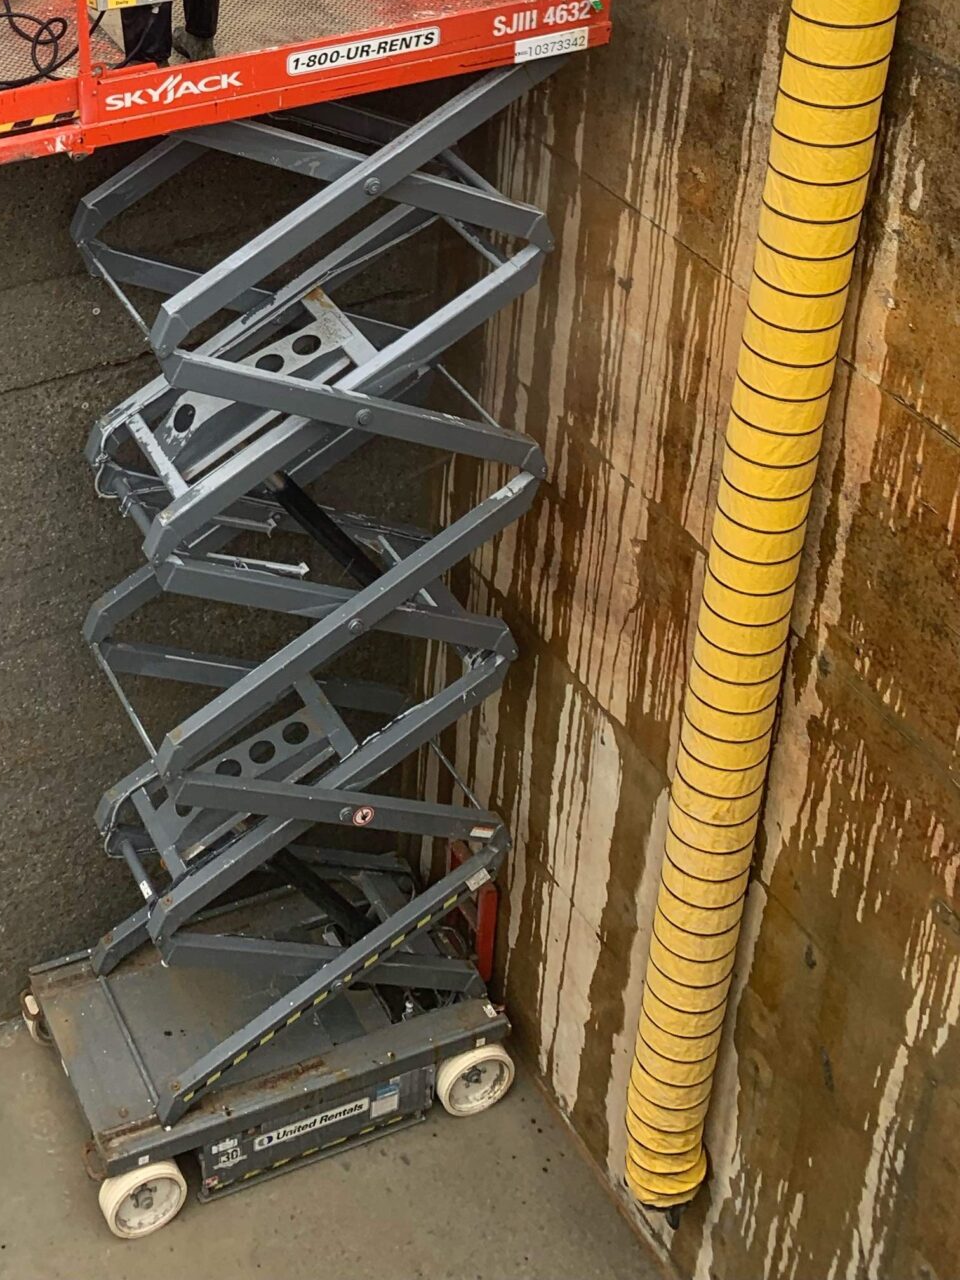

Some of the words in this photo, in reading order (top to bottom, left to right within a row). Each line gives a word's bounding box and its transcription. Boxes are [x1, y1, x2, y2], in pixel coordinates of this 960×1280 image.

[543, 0, 592, 26] 4632
[292, 31, 436, 71] 1-800-UR-RENTS
[528, 35, 586, 57] 10373342
[105, 71, 244, 111] SKYJACK
[276, 1118, 318, 1141] United
[319, 1103, 364, 1125] Rentals
